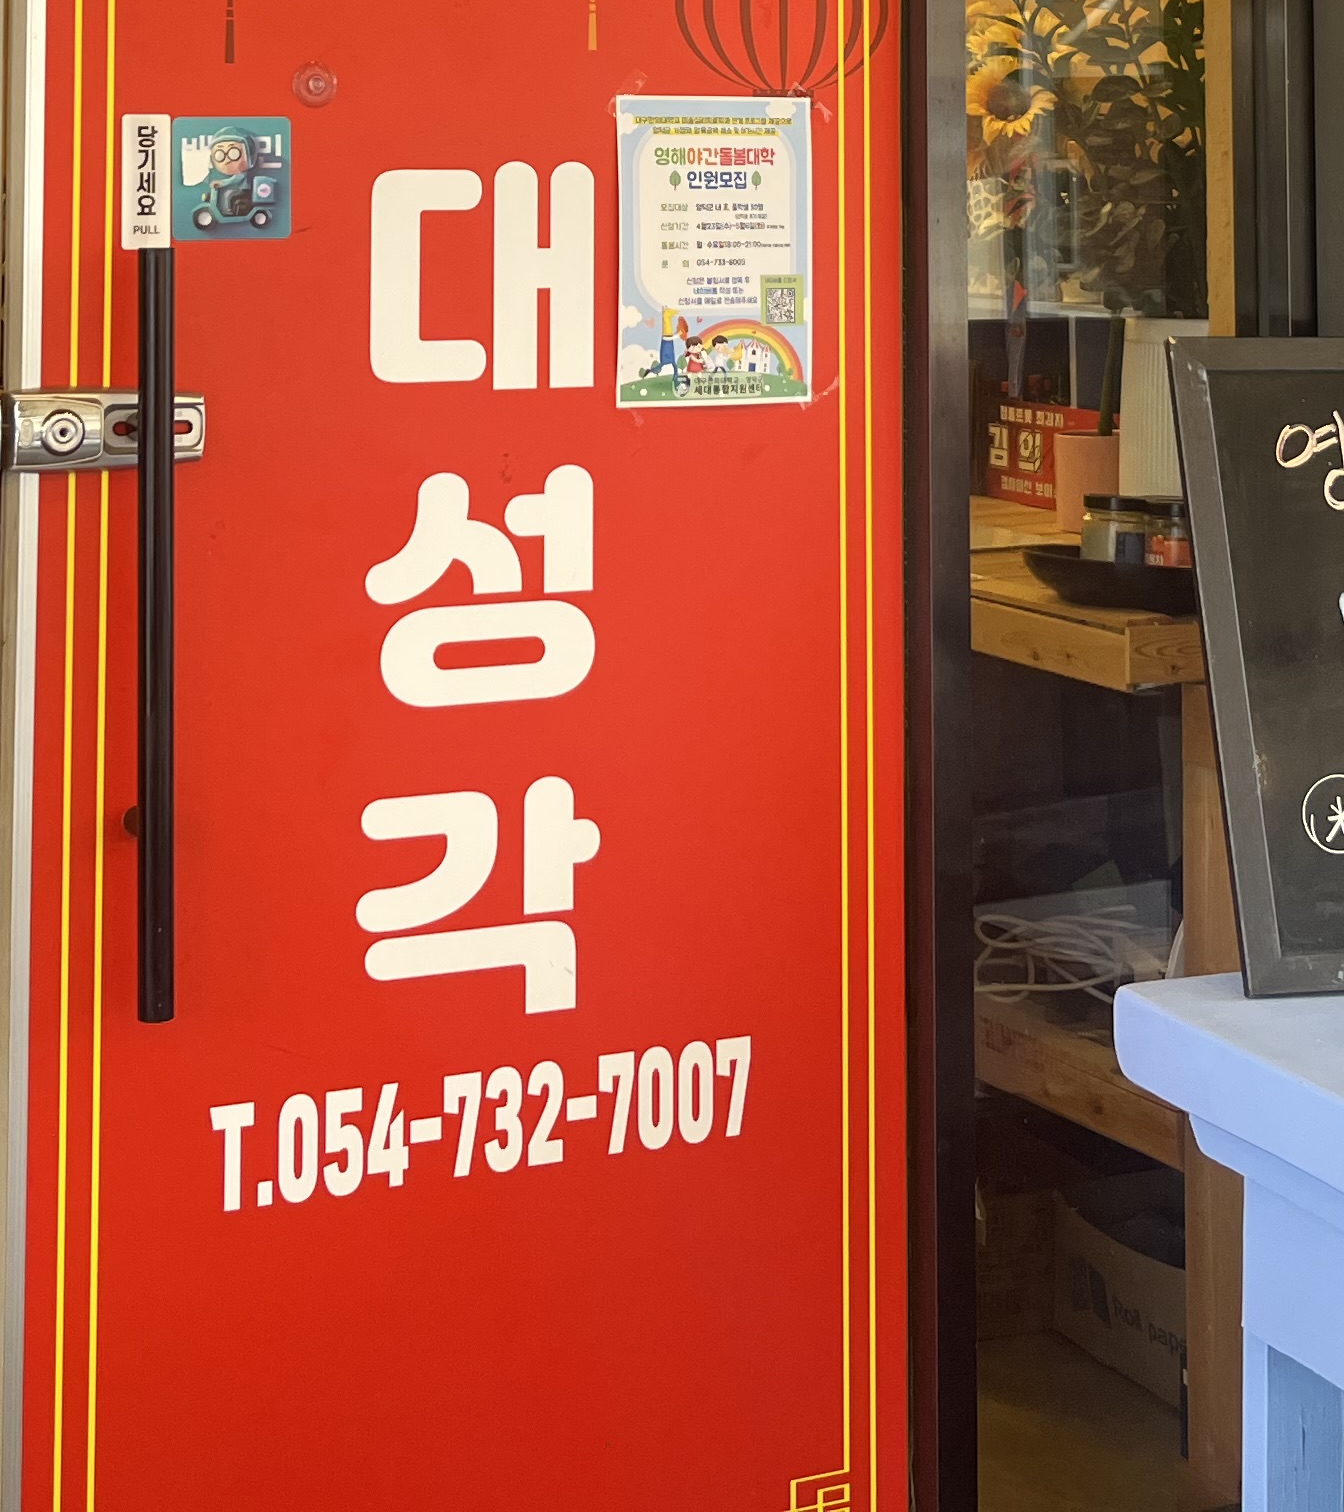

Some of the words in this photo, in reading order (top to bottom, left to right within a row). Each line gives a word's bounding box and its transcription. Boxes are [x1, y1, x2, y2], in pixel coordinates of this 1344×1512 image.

[137, 125, 158, 217] 당기세요
[654, 147, 776, 166] 영해야간돌봄대학
[687, 171, 747, 190] 인원모집
[133, 224, 160, 236] PULL
[355, 160, 601, 1015] 대성각
[210, 1035, 752, 1211] T.054-732-7007
